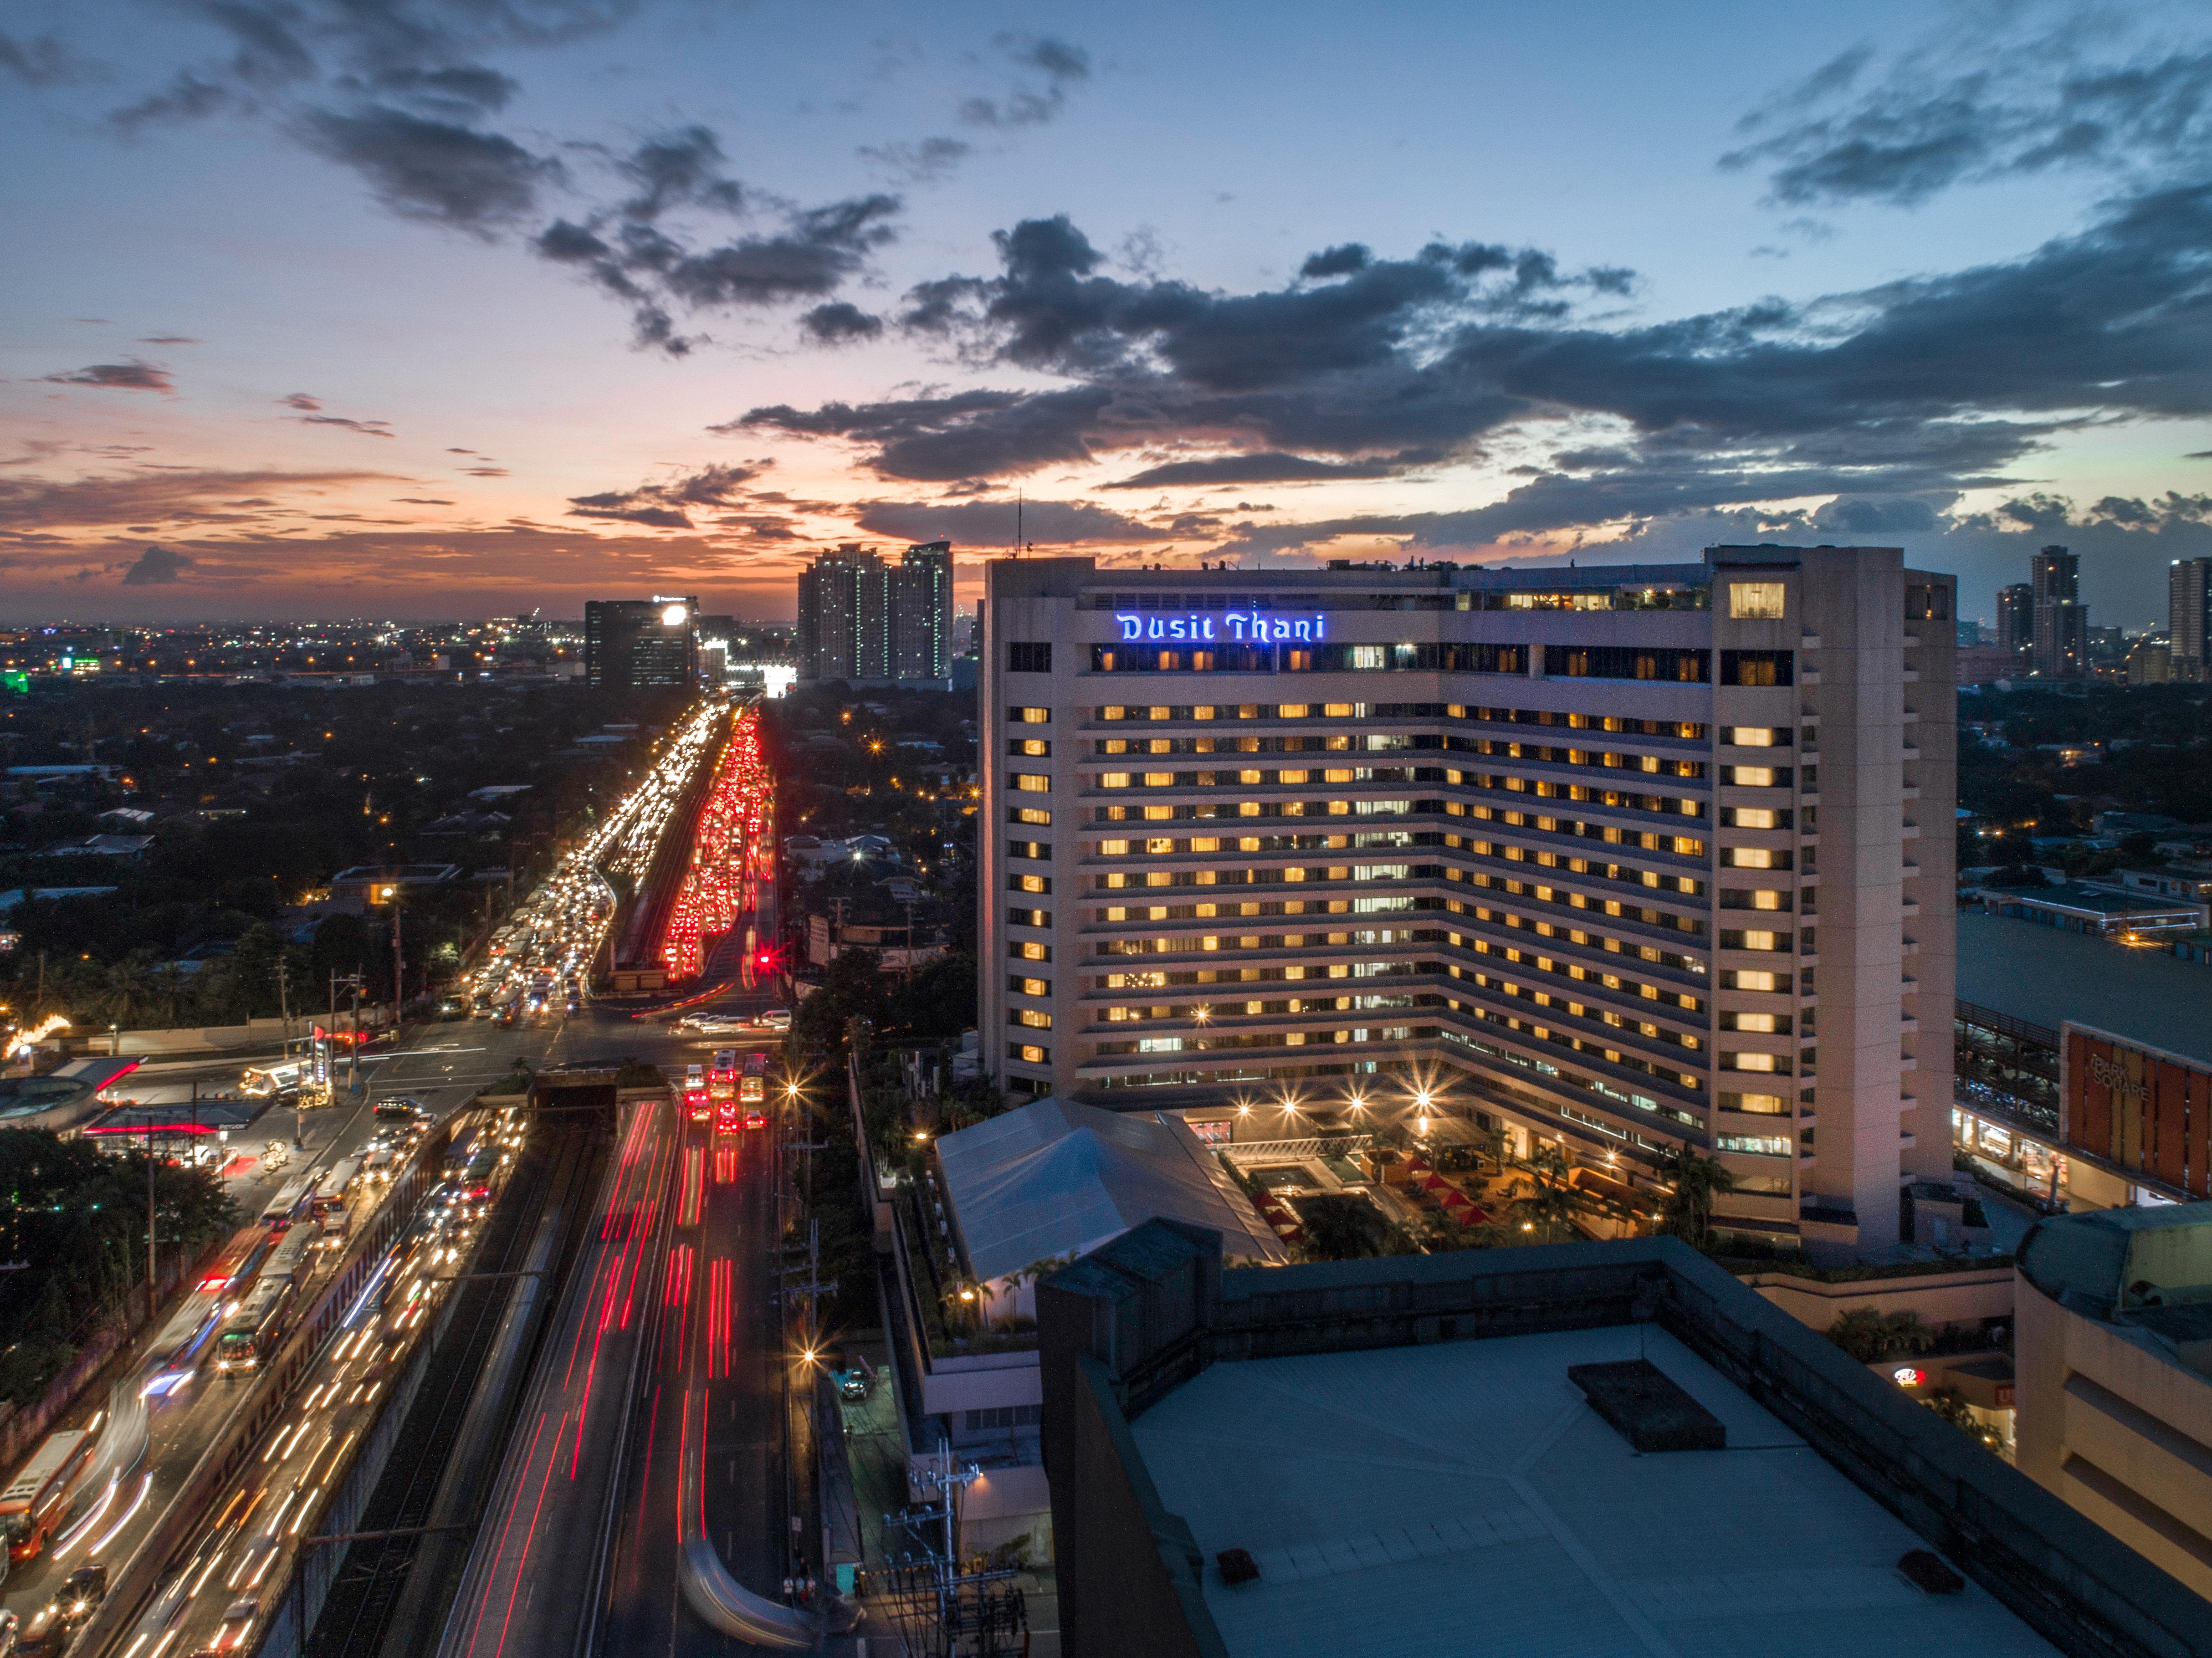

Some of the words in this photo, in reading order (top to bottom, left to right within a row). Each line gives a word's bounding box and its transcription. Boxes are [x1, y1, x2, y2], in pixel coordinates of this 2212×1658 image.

[1116, 613, 1215, 639] Dusit
[1225, 611, 1324, 643] Thani
[2093, 1054, 2128, 1080] PARK
[2094, 1071, 2150, 1101] SQUARE
